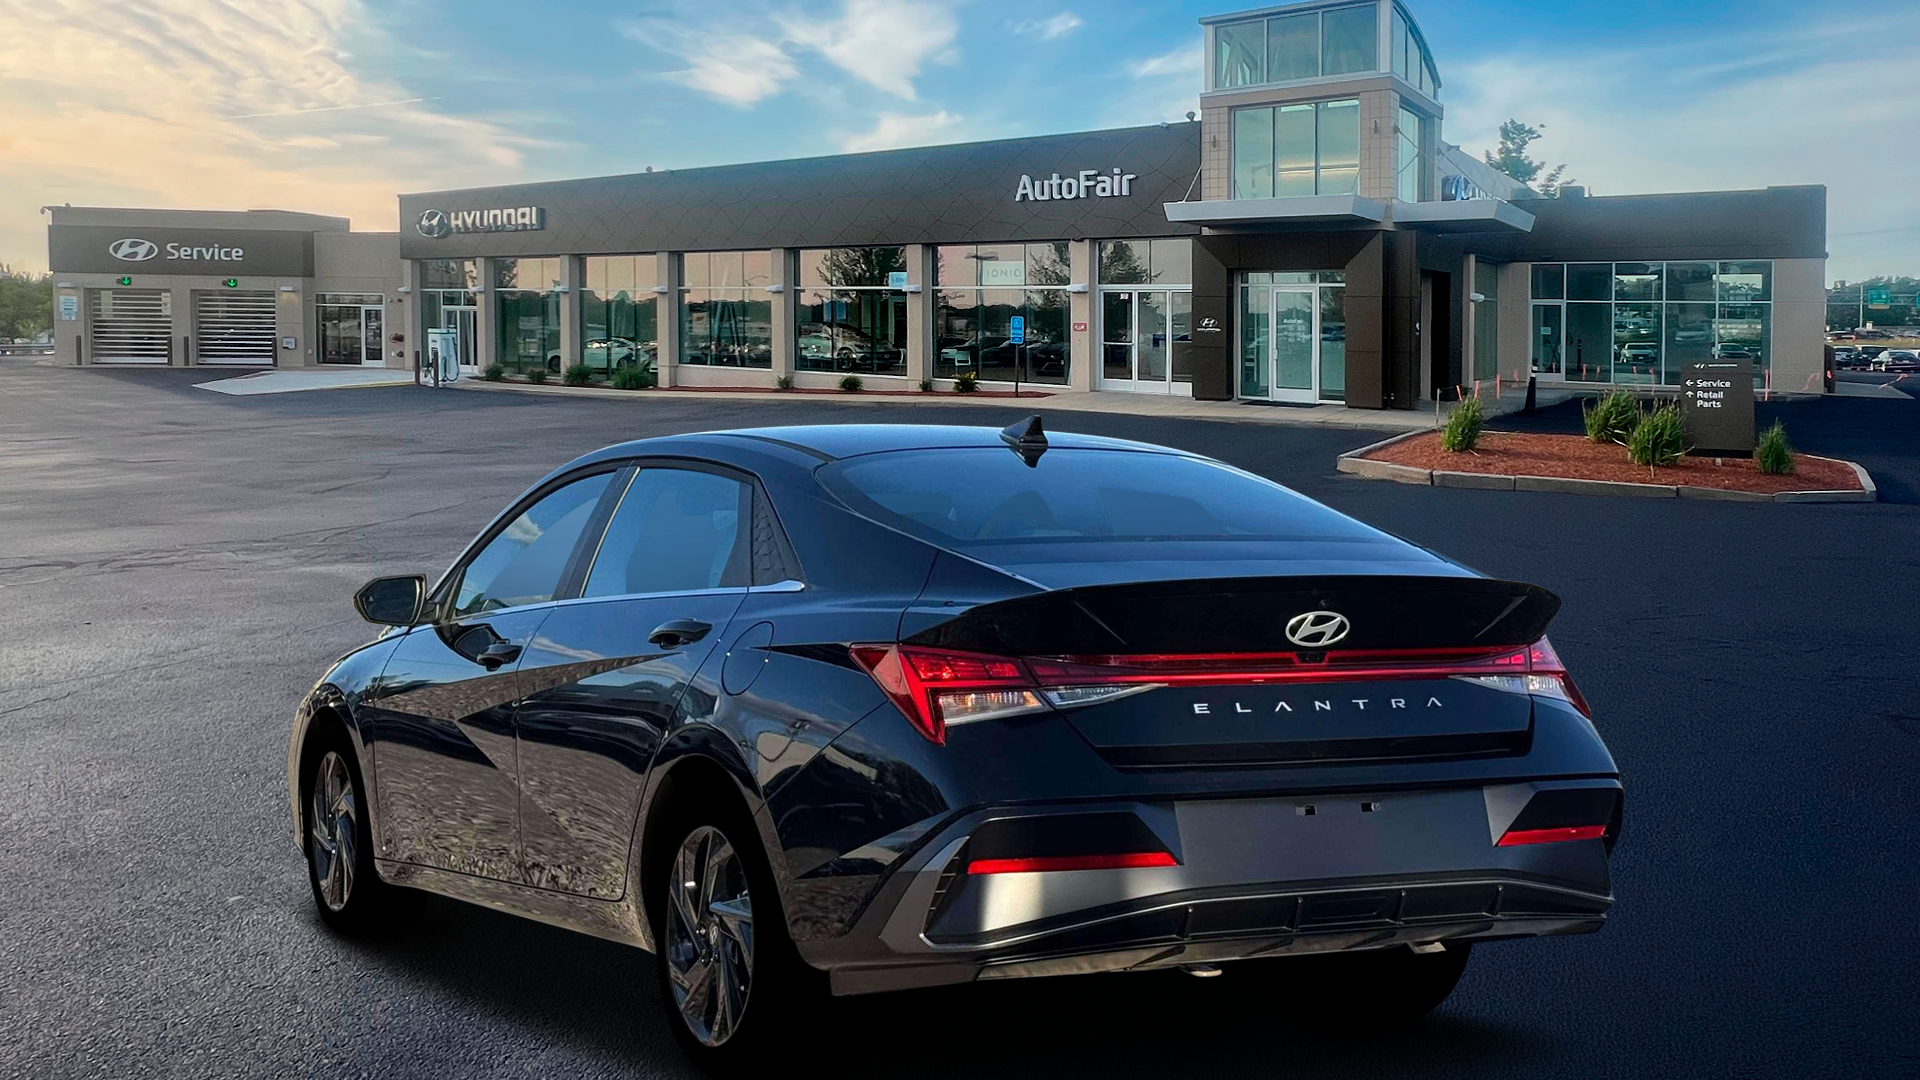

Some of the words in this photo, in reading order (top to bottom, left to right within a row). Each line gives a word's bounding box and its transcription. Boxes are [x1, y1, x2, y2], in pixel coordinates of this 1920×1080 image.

[1015, 167, 1137, 201] AutoFair
[450, 206, 541, 232] HYUNDAI
[166, 242, 244, 260] Service
[1696, 379, 1731, 388] Service
[1696, 390, 1724, 399] Retail
[1696, 400, 1722, 408] Parts
[1193, 697, 1443, 714] ELANTRA
